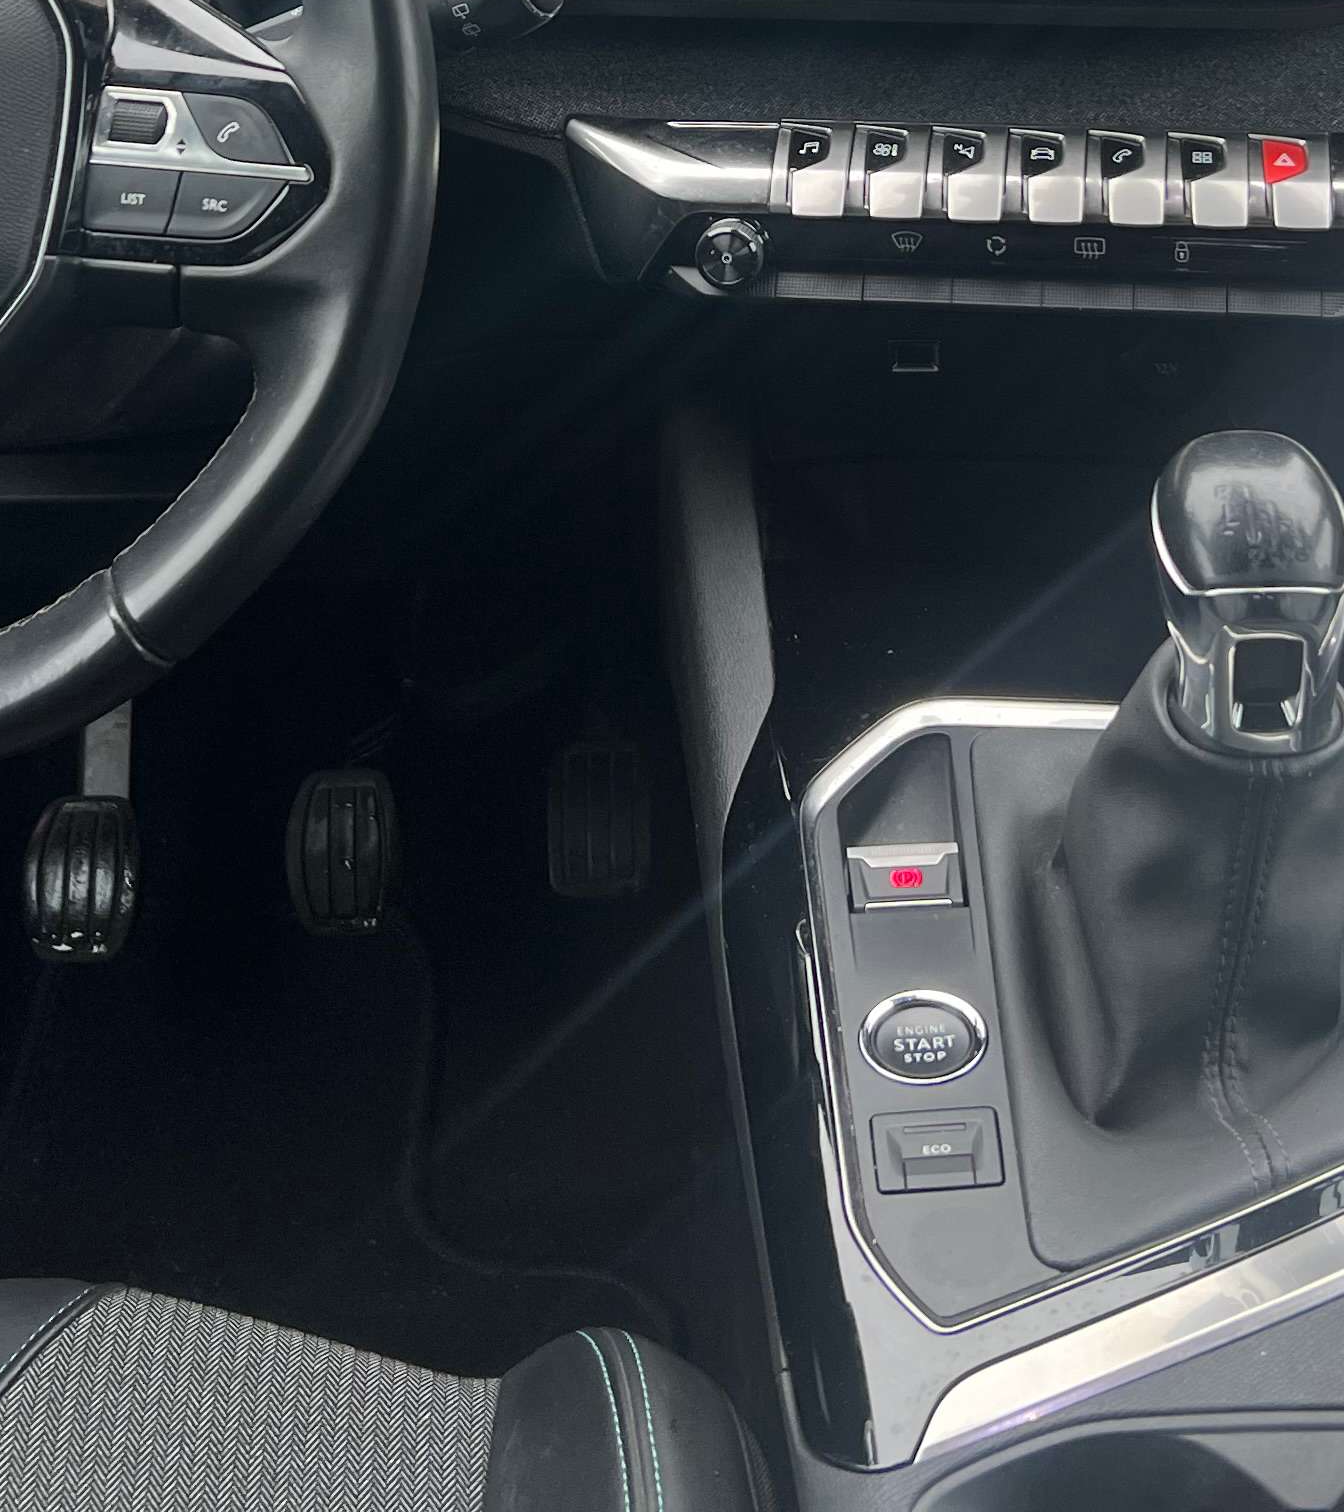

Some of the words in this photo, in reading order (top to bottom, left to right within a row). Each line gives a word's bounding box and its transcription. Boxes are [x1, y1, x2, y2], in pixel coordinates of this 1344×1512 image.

[120, 192, 146, 205] LIST
[201, 198, 228, 212] SRC
[897, 1024, 945, 1036] ENGINE
[894, 1035, 955, 1052] START
[904, 1051, 947, 1063] STOP
[922, 1143, 951, 1155] ECO
